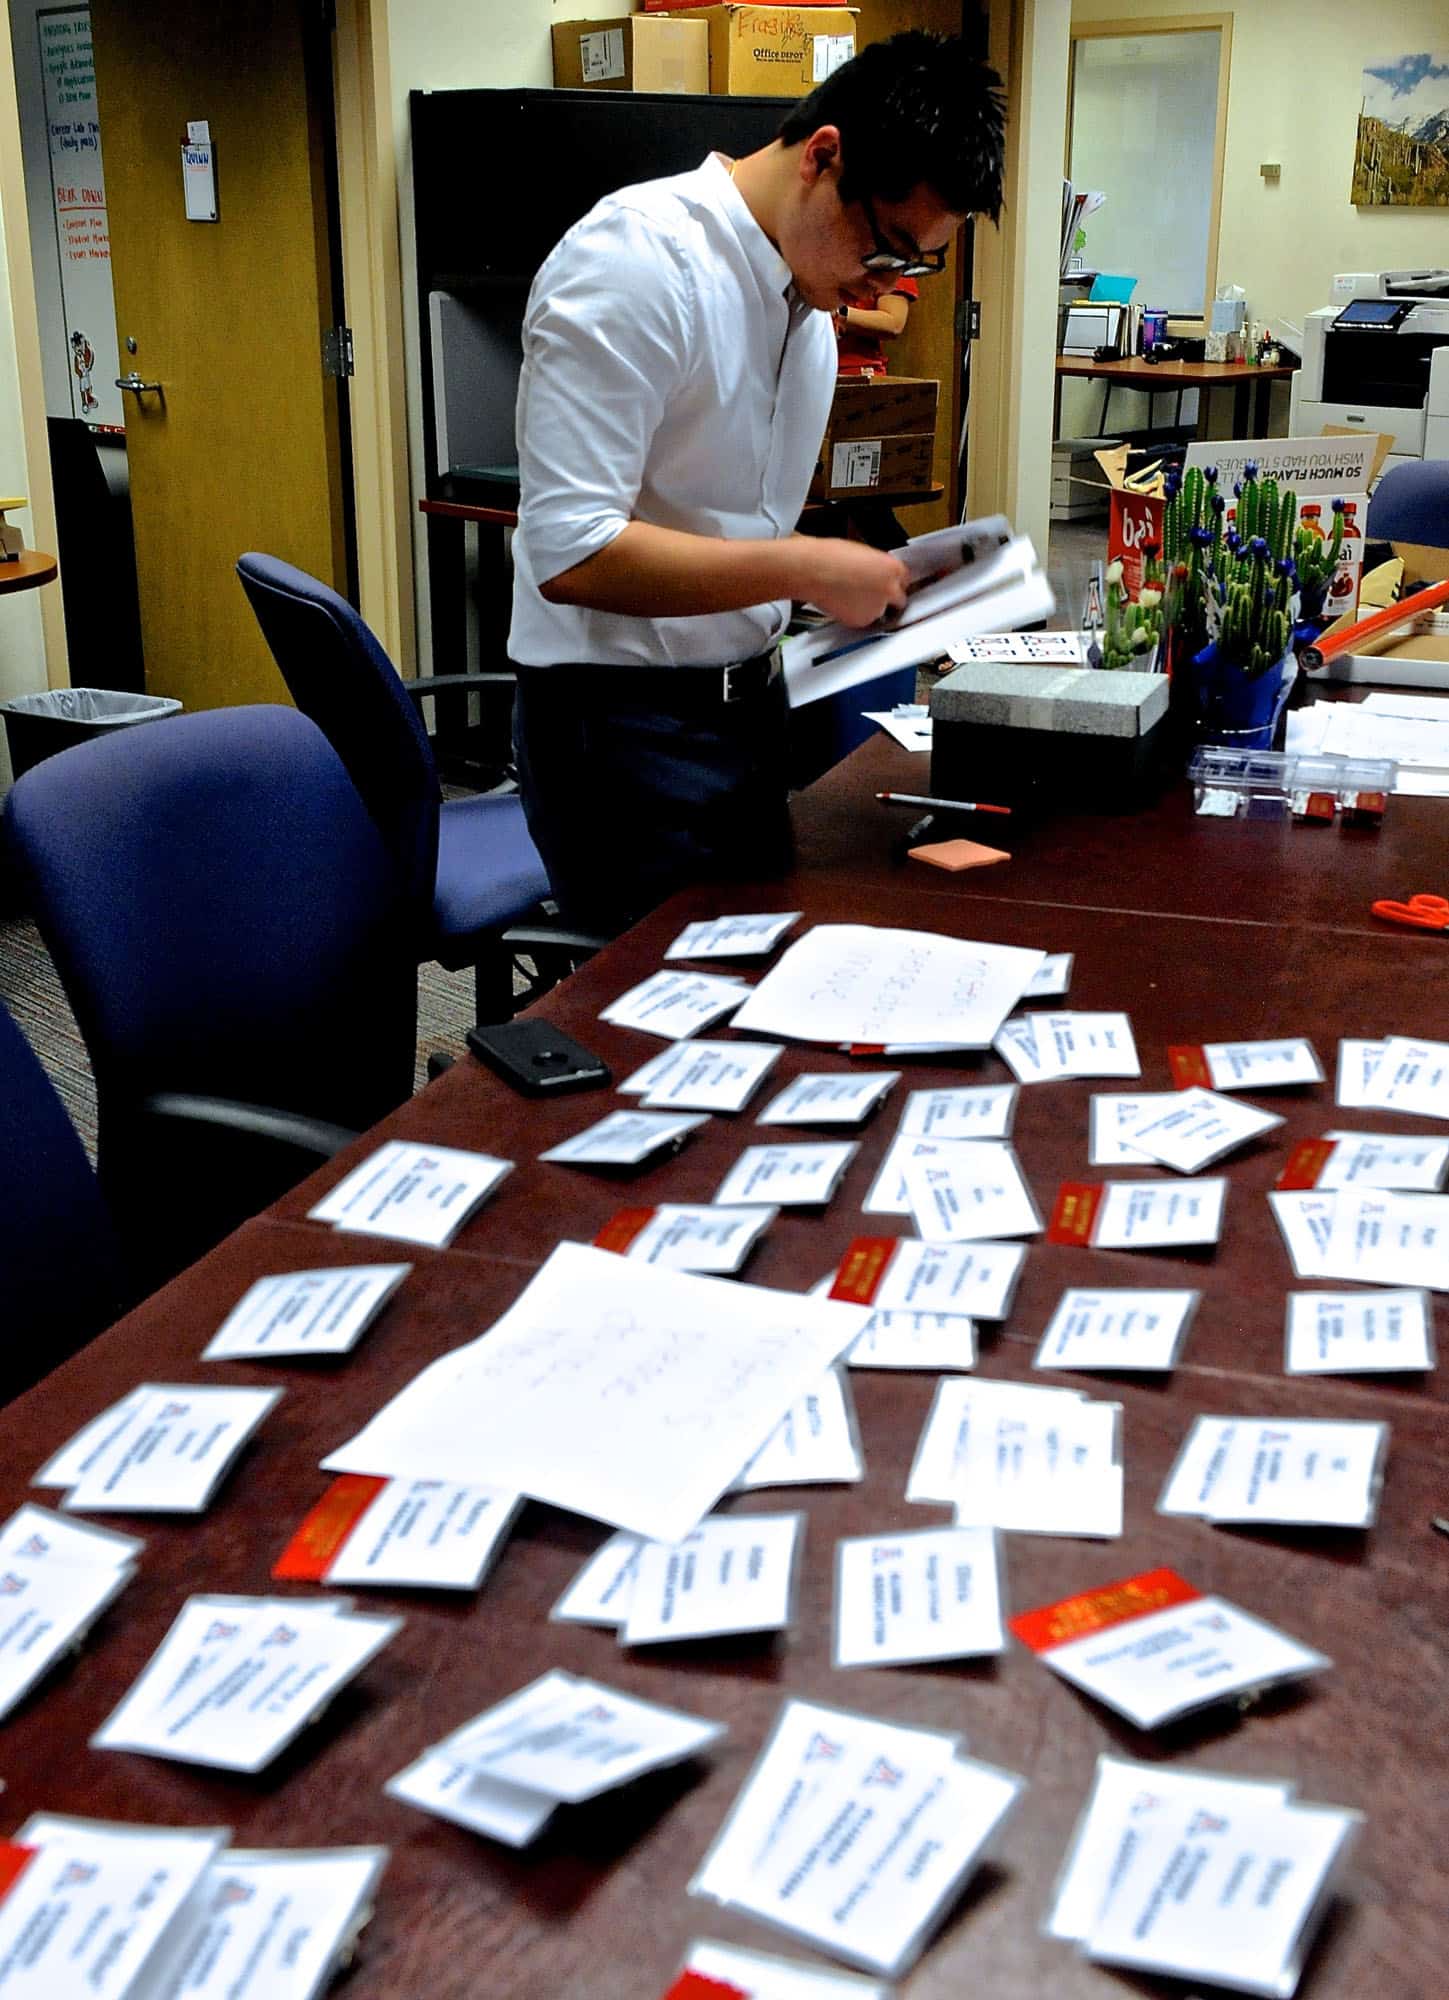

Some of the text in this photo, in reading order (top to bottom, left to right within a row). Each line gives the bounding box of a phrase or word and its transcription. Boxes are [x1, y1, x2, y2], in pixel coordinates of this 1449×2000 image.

[753, 48, 779, 57] Office
[1282, 455, 1307, 467] HAD
[1310, 454, 1333, 466] YOU
[1335, 452, 1364, 465] WISH
[1263, 466, 1362, 481] SO MUCH FLAVOR
[1339, 544, 1352, 561] ai
